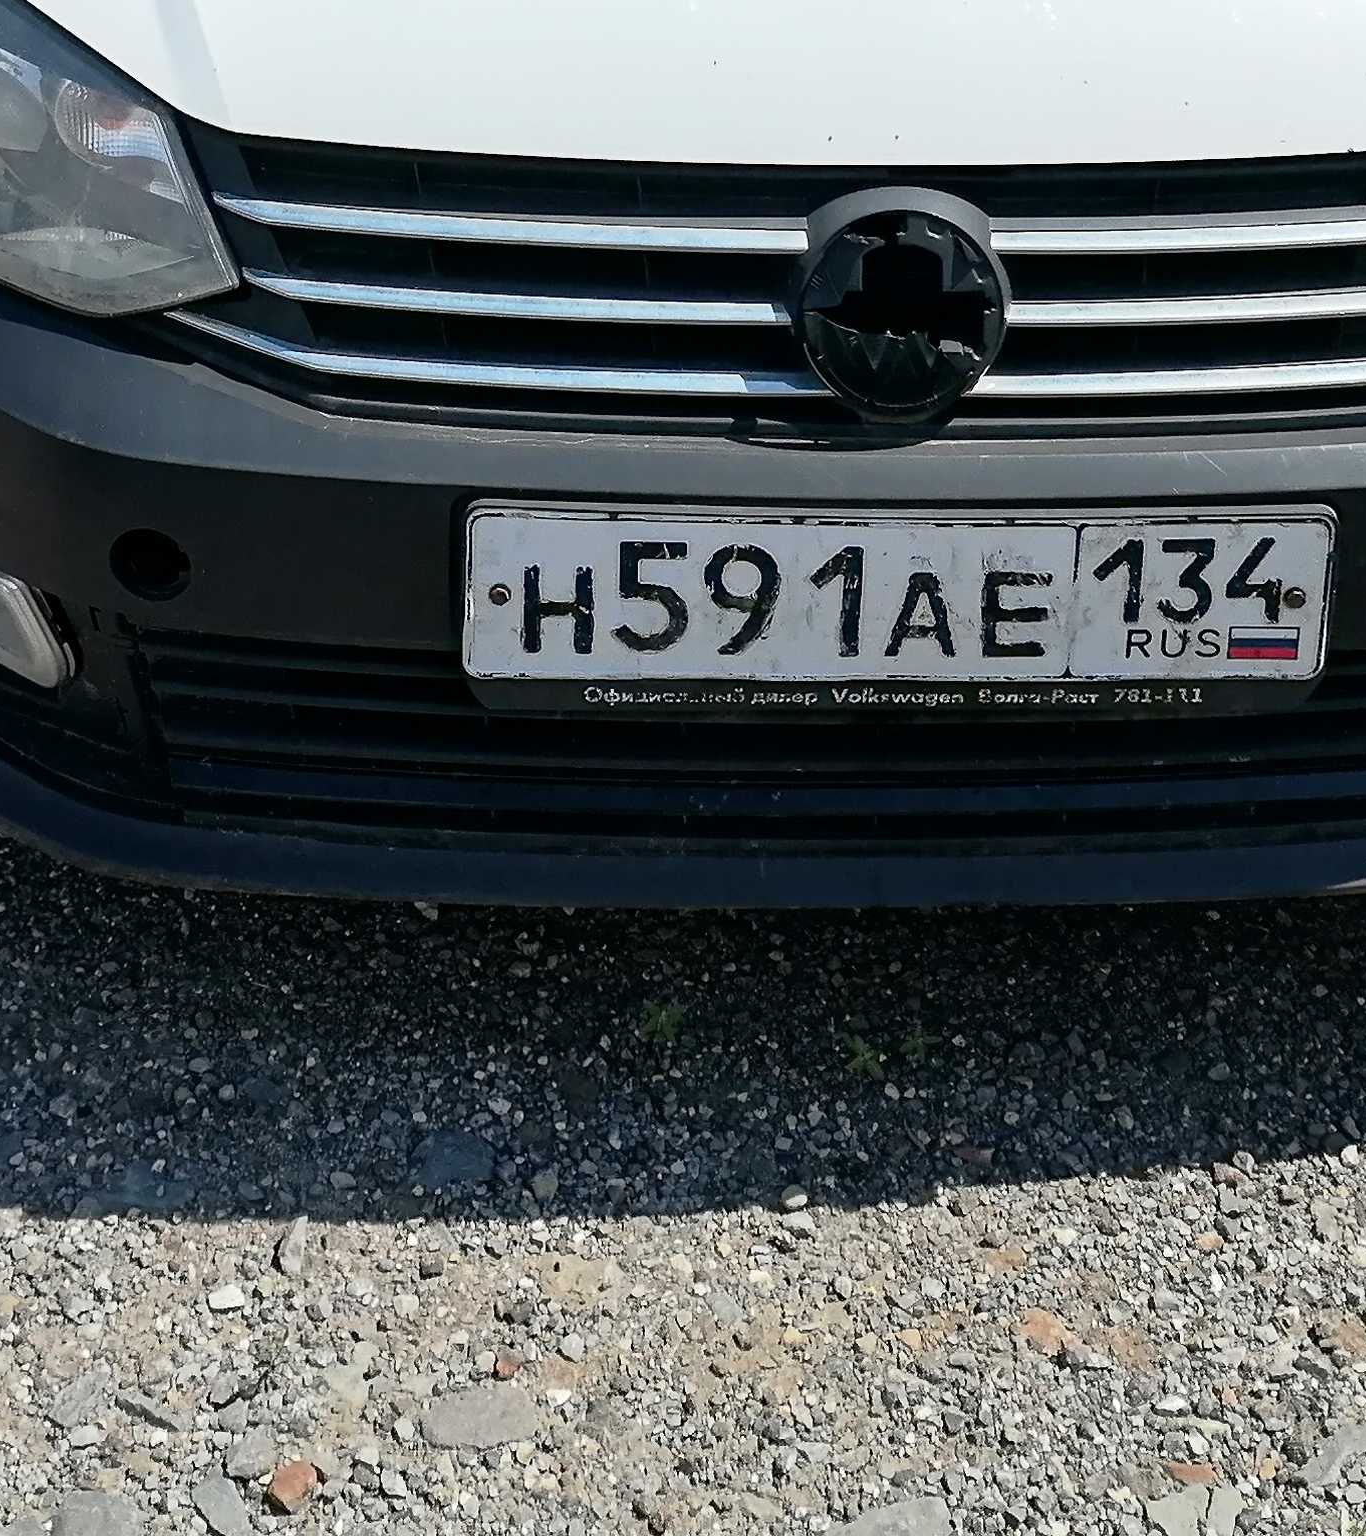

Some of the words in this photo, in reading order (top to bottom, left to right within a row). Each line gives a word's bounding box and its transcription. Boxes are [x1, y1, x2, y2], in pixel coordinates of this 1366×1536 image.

[522, 540, 1054, 657] Н591АЕ
[1092, 537, 1282, 624] 134
[1125, 628, 1222, 660] RUS
[831, 687, 965, 706] Volkswagen
